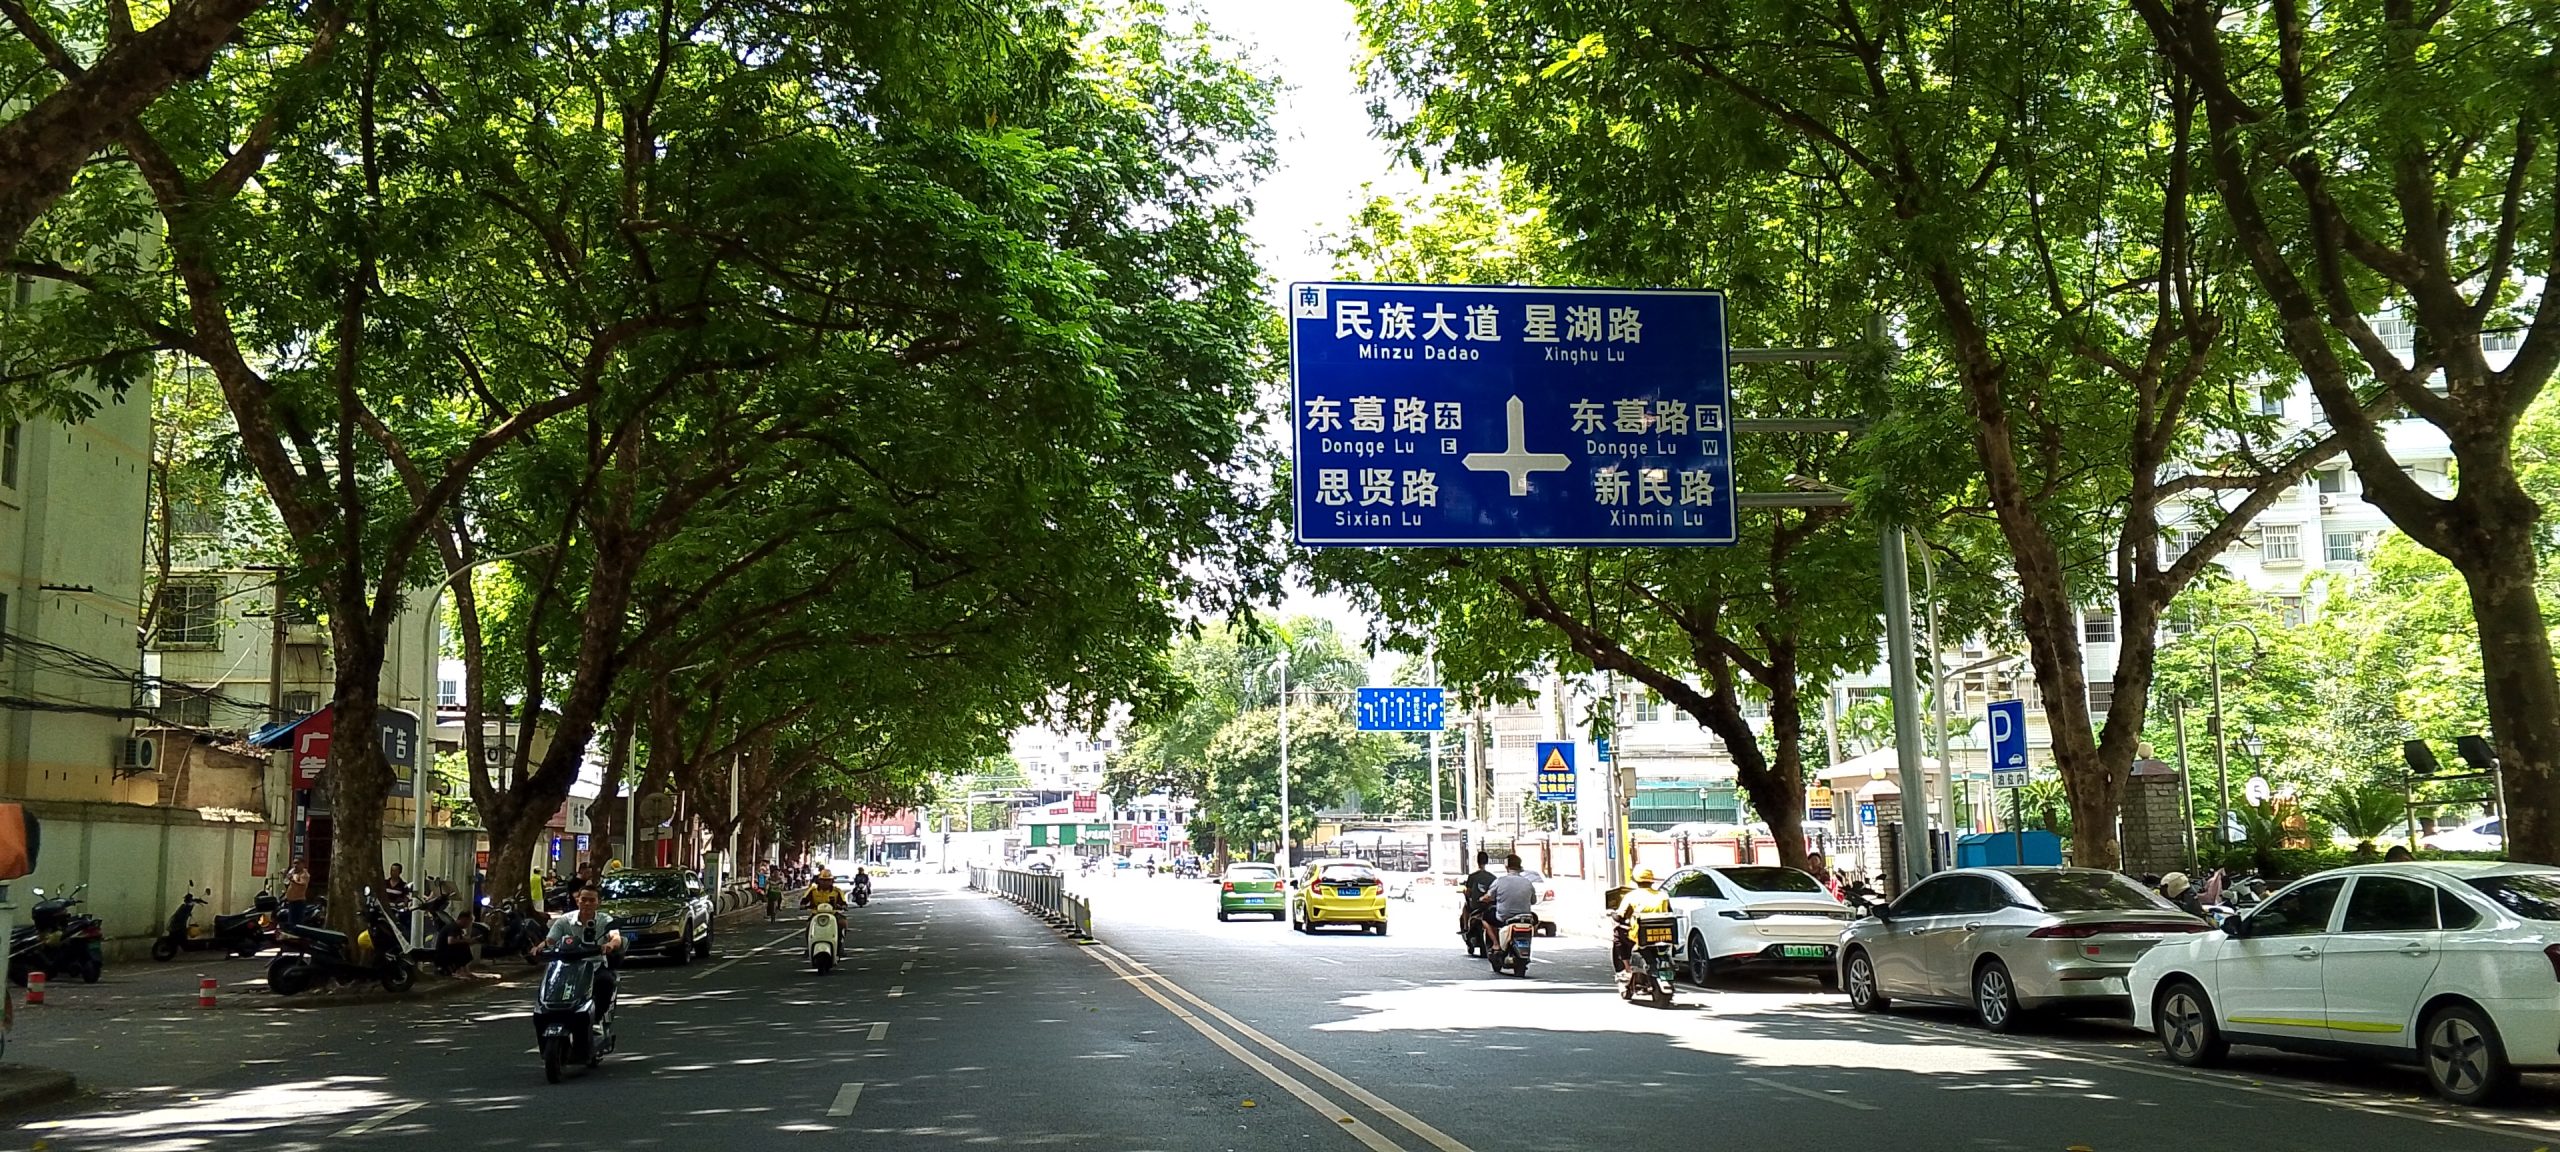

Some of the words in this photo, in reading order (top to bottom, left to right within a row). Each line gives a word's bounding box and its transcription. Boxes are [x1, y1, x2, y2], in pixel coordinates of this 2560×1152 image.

[1298, 288, 1320, 308] 南
[1335, 300, 1501, 342] 民族大道
[1523, 304, 1643, 344] 星湖路
[1359, 344, 1414, 360] Minzu
[1425, 346, 1480, 361] Dadao
[1545, 346, 1599, 365] Xinghu
[1607, 348, 1625, 362] Lu
[1304, 396, 1429, 432] 东葛路
[1436, 404, 1460, 428] 东
[1570, 399, 1690, 435] 东葛路
[1699, 406, 1720, 429] 西
[1321, 438, 1385, 458] Dongge
[1395, 439, 1414, 454] Lu
[1444, 439, 1454, 452] E
[1586, 440, 1648, 459] Dongge
[1658, 440, 1676, 455] Lu
[1703, 441, 1718, 455] W
[1316, 468, 1439, 507] 思贤路
[1595, 469, 1716, 507] 新民路
[1335, 511, 1392, 527] Sixian
[1403, 511, 1422, 527] Lu
[1610, 510, 1673, 527] Xinmin
[1684, 511, 1703, 527] Lu
[382, 725, 407, 760] 广告
[1991, 709, 2012, 764] P
[300, 732, 330, 779] 广告
